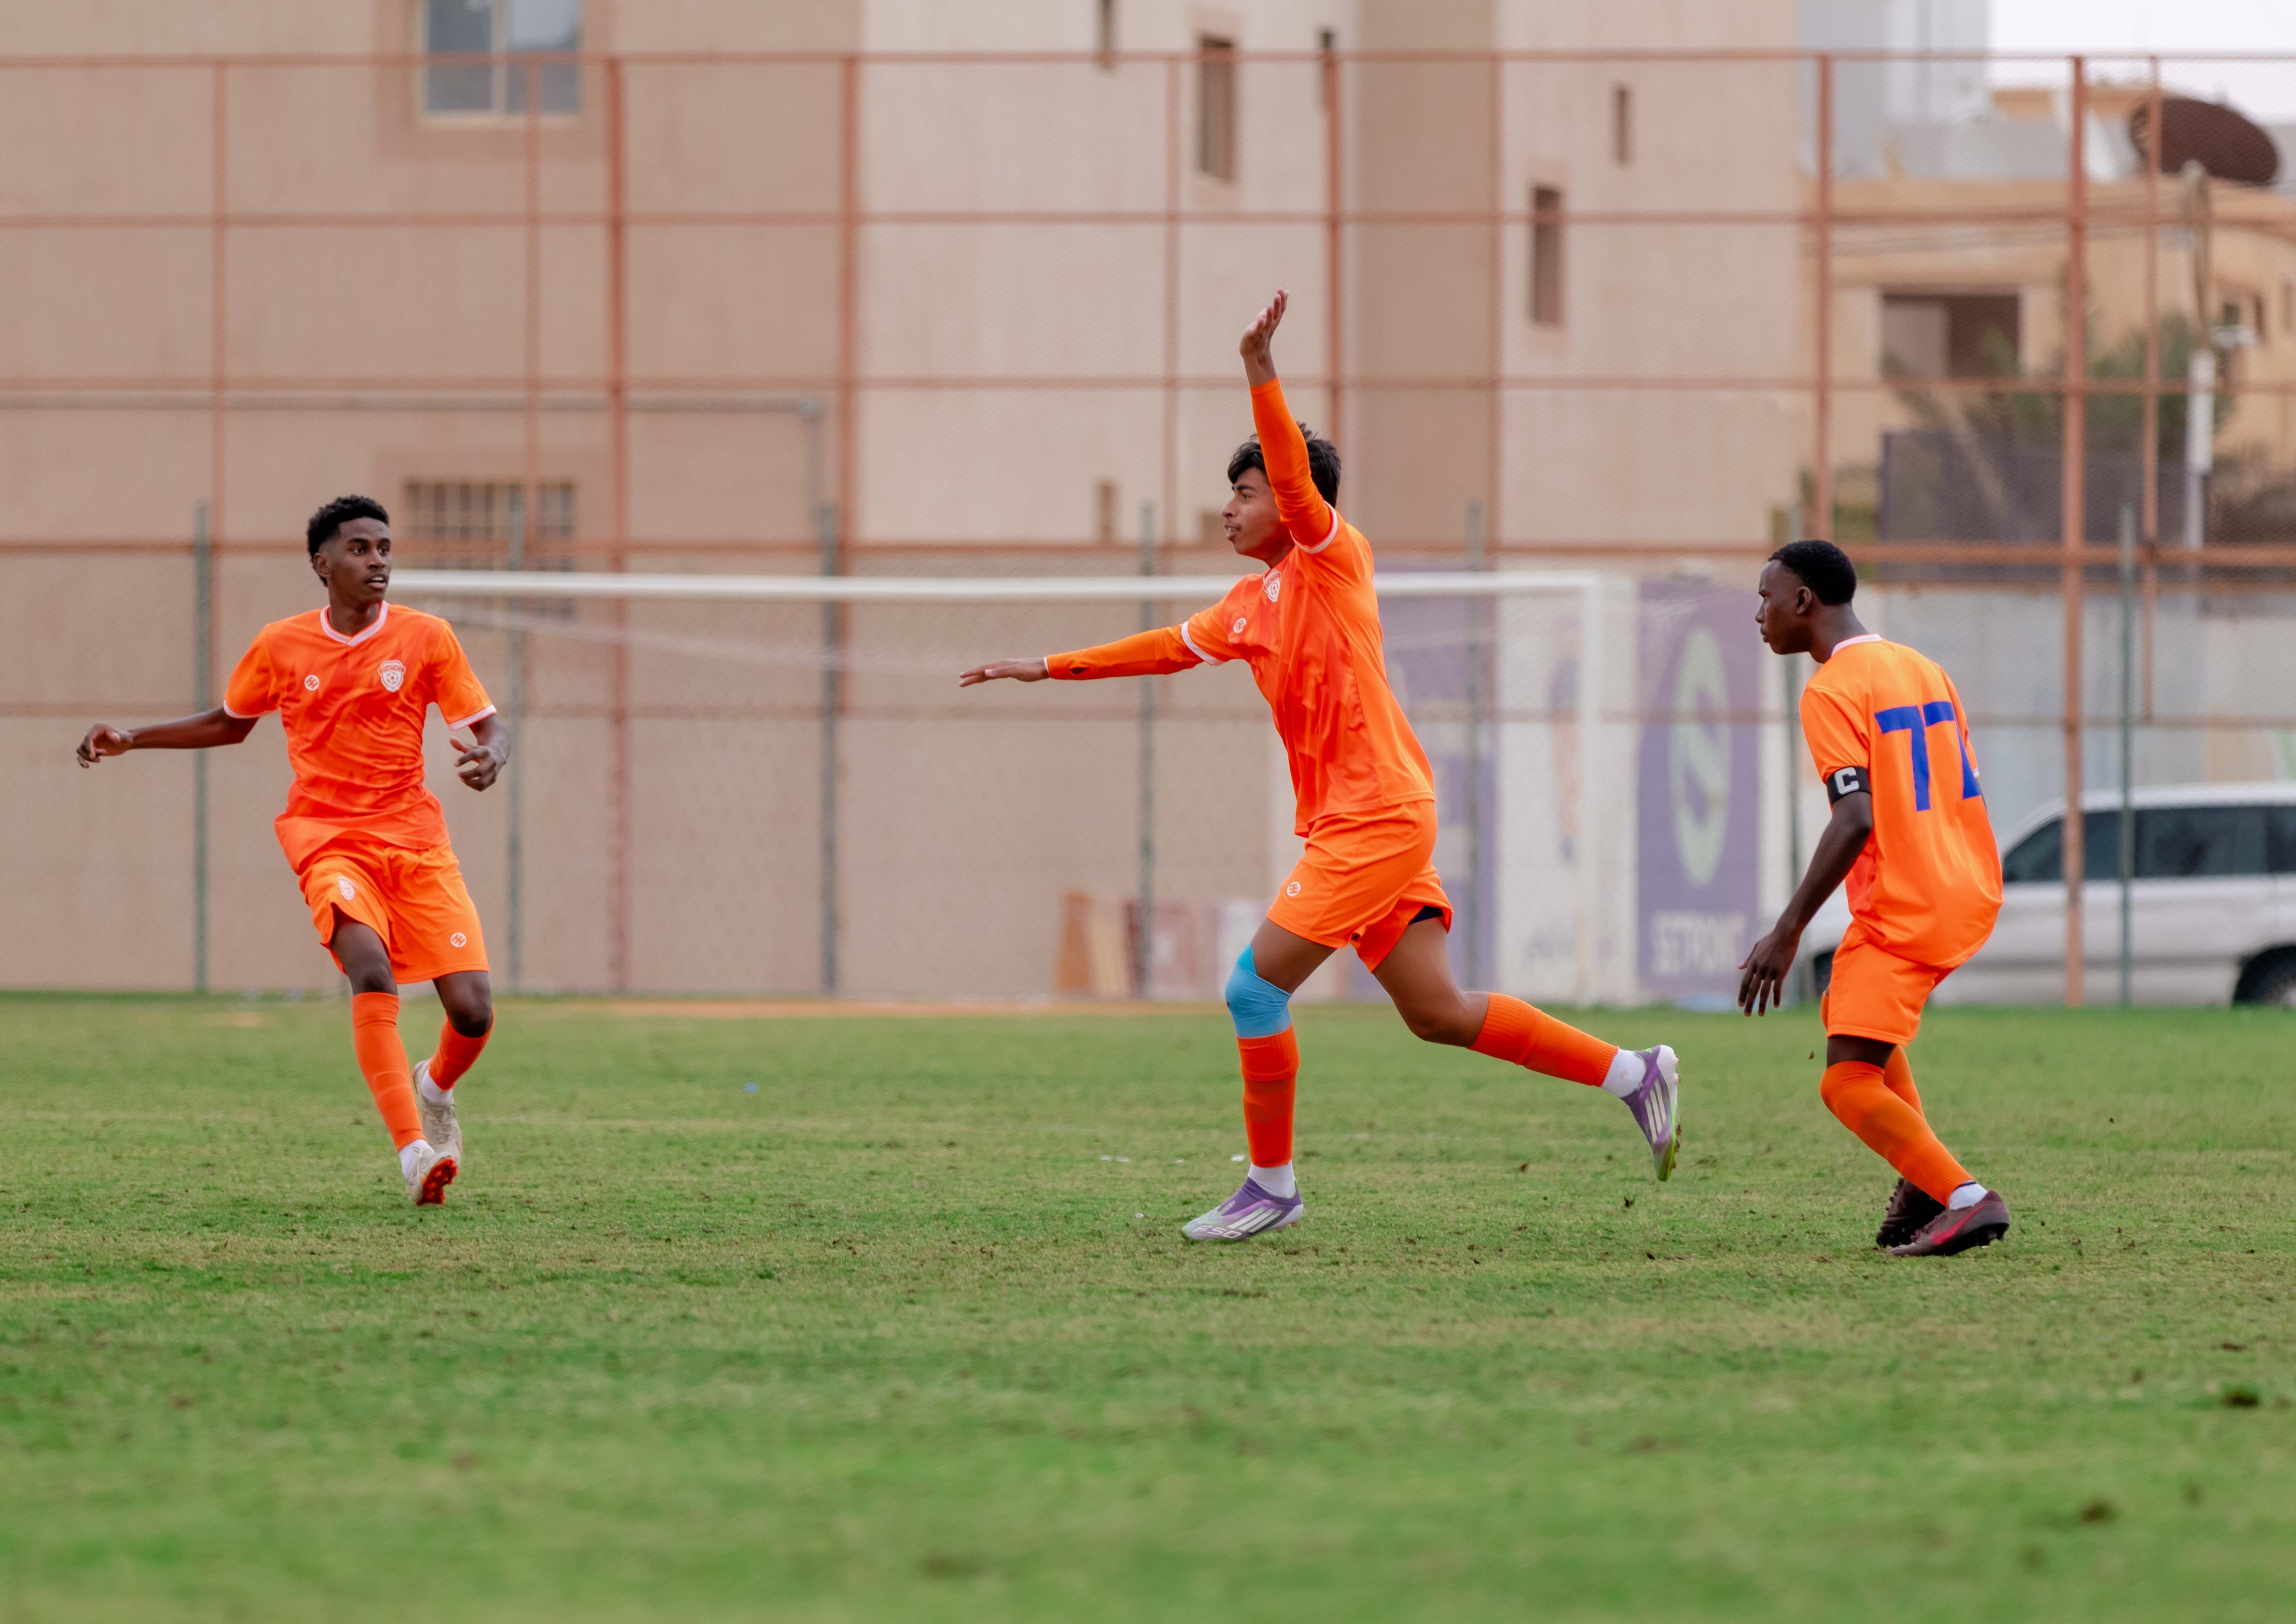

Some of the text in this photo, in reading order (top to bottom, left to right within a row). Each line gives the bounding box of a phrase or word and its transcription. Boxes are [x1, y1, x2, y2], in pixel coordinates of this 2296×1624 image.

[1874, 700, 1982, 812] 77
[1834, 767, 1860, 795] C
[1191, 1224, 1242, 1238] F50
